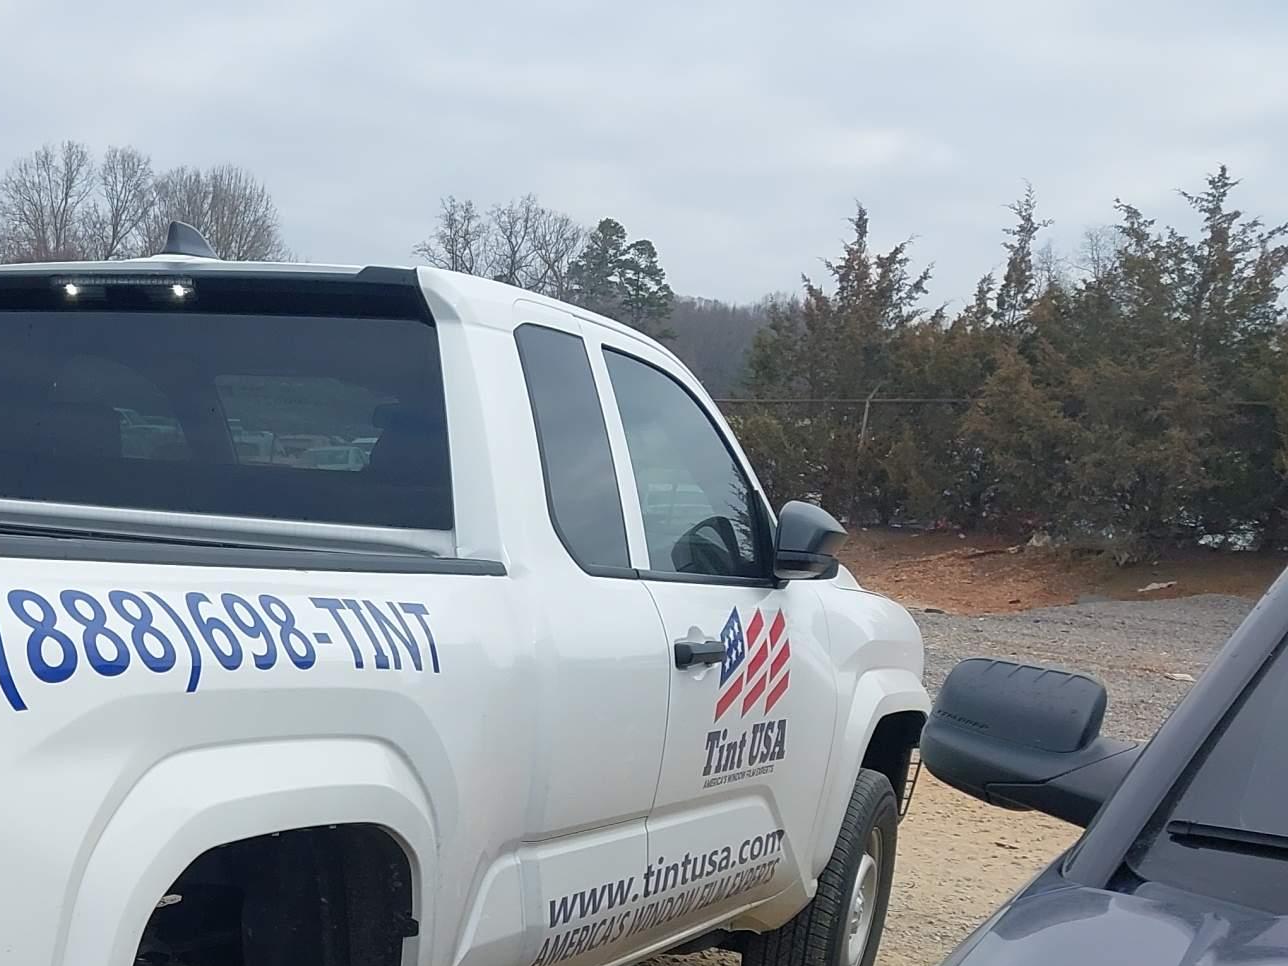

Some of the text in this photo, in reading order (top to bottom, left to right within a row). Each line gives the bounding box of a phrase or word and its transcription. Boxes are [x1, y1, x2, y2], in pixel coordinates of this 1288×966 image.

[702, 719, 787, 777] Tint USA
[549, 829, 785, 929] www.tintusa.com
[625, 886, 702, 938] WINDOW
[693, 873, 733, 912] FILM
[725, 858, 780, 899] EXPERTS
